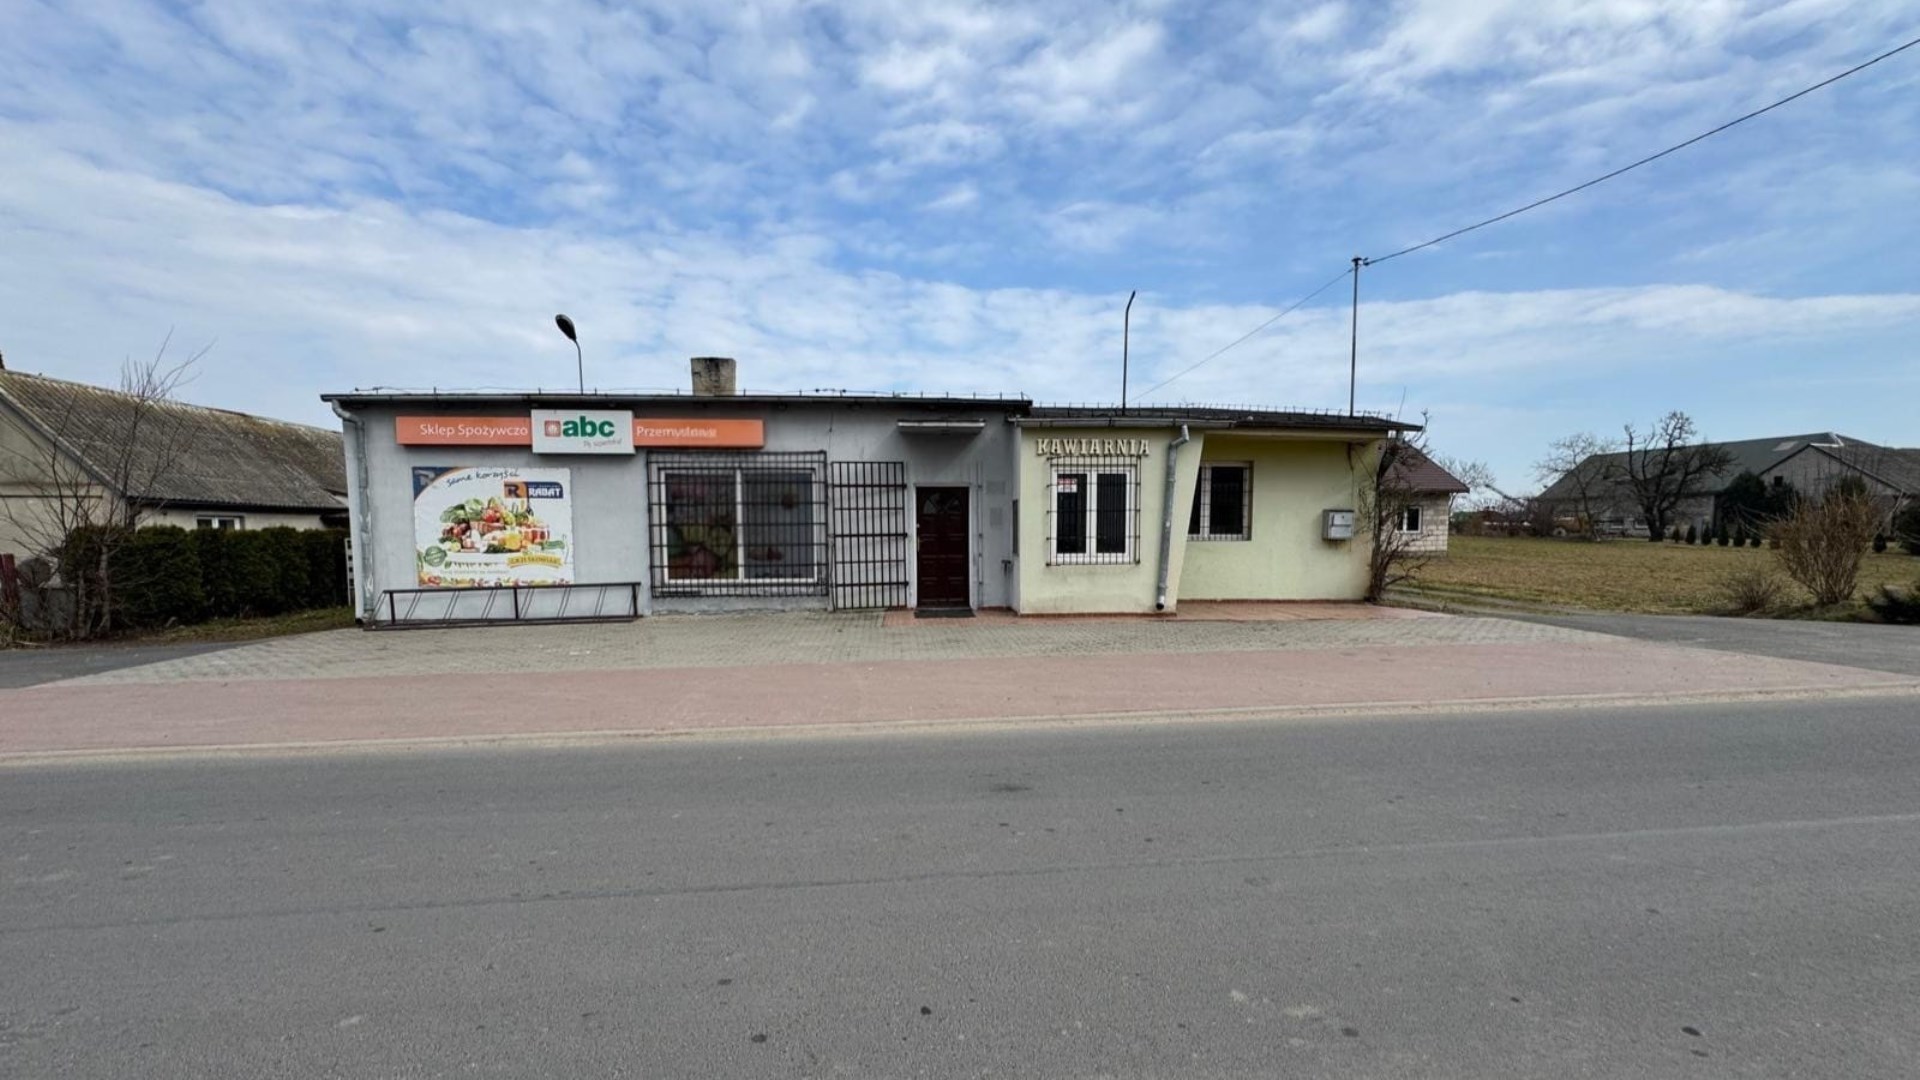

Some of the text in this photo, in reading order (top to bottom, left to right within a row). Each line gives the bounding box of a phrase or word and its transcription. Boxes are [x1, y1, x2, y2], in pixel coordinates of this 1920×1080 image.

[419, 423, 529, 438] Sklep Spożywczo
[562, 415, 616, 438] abc
[1036, 438, 1150, 456] KAWIARNIA
[528, 487, 561, 497] RABAT
